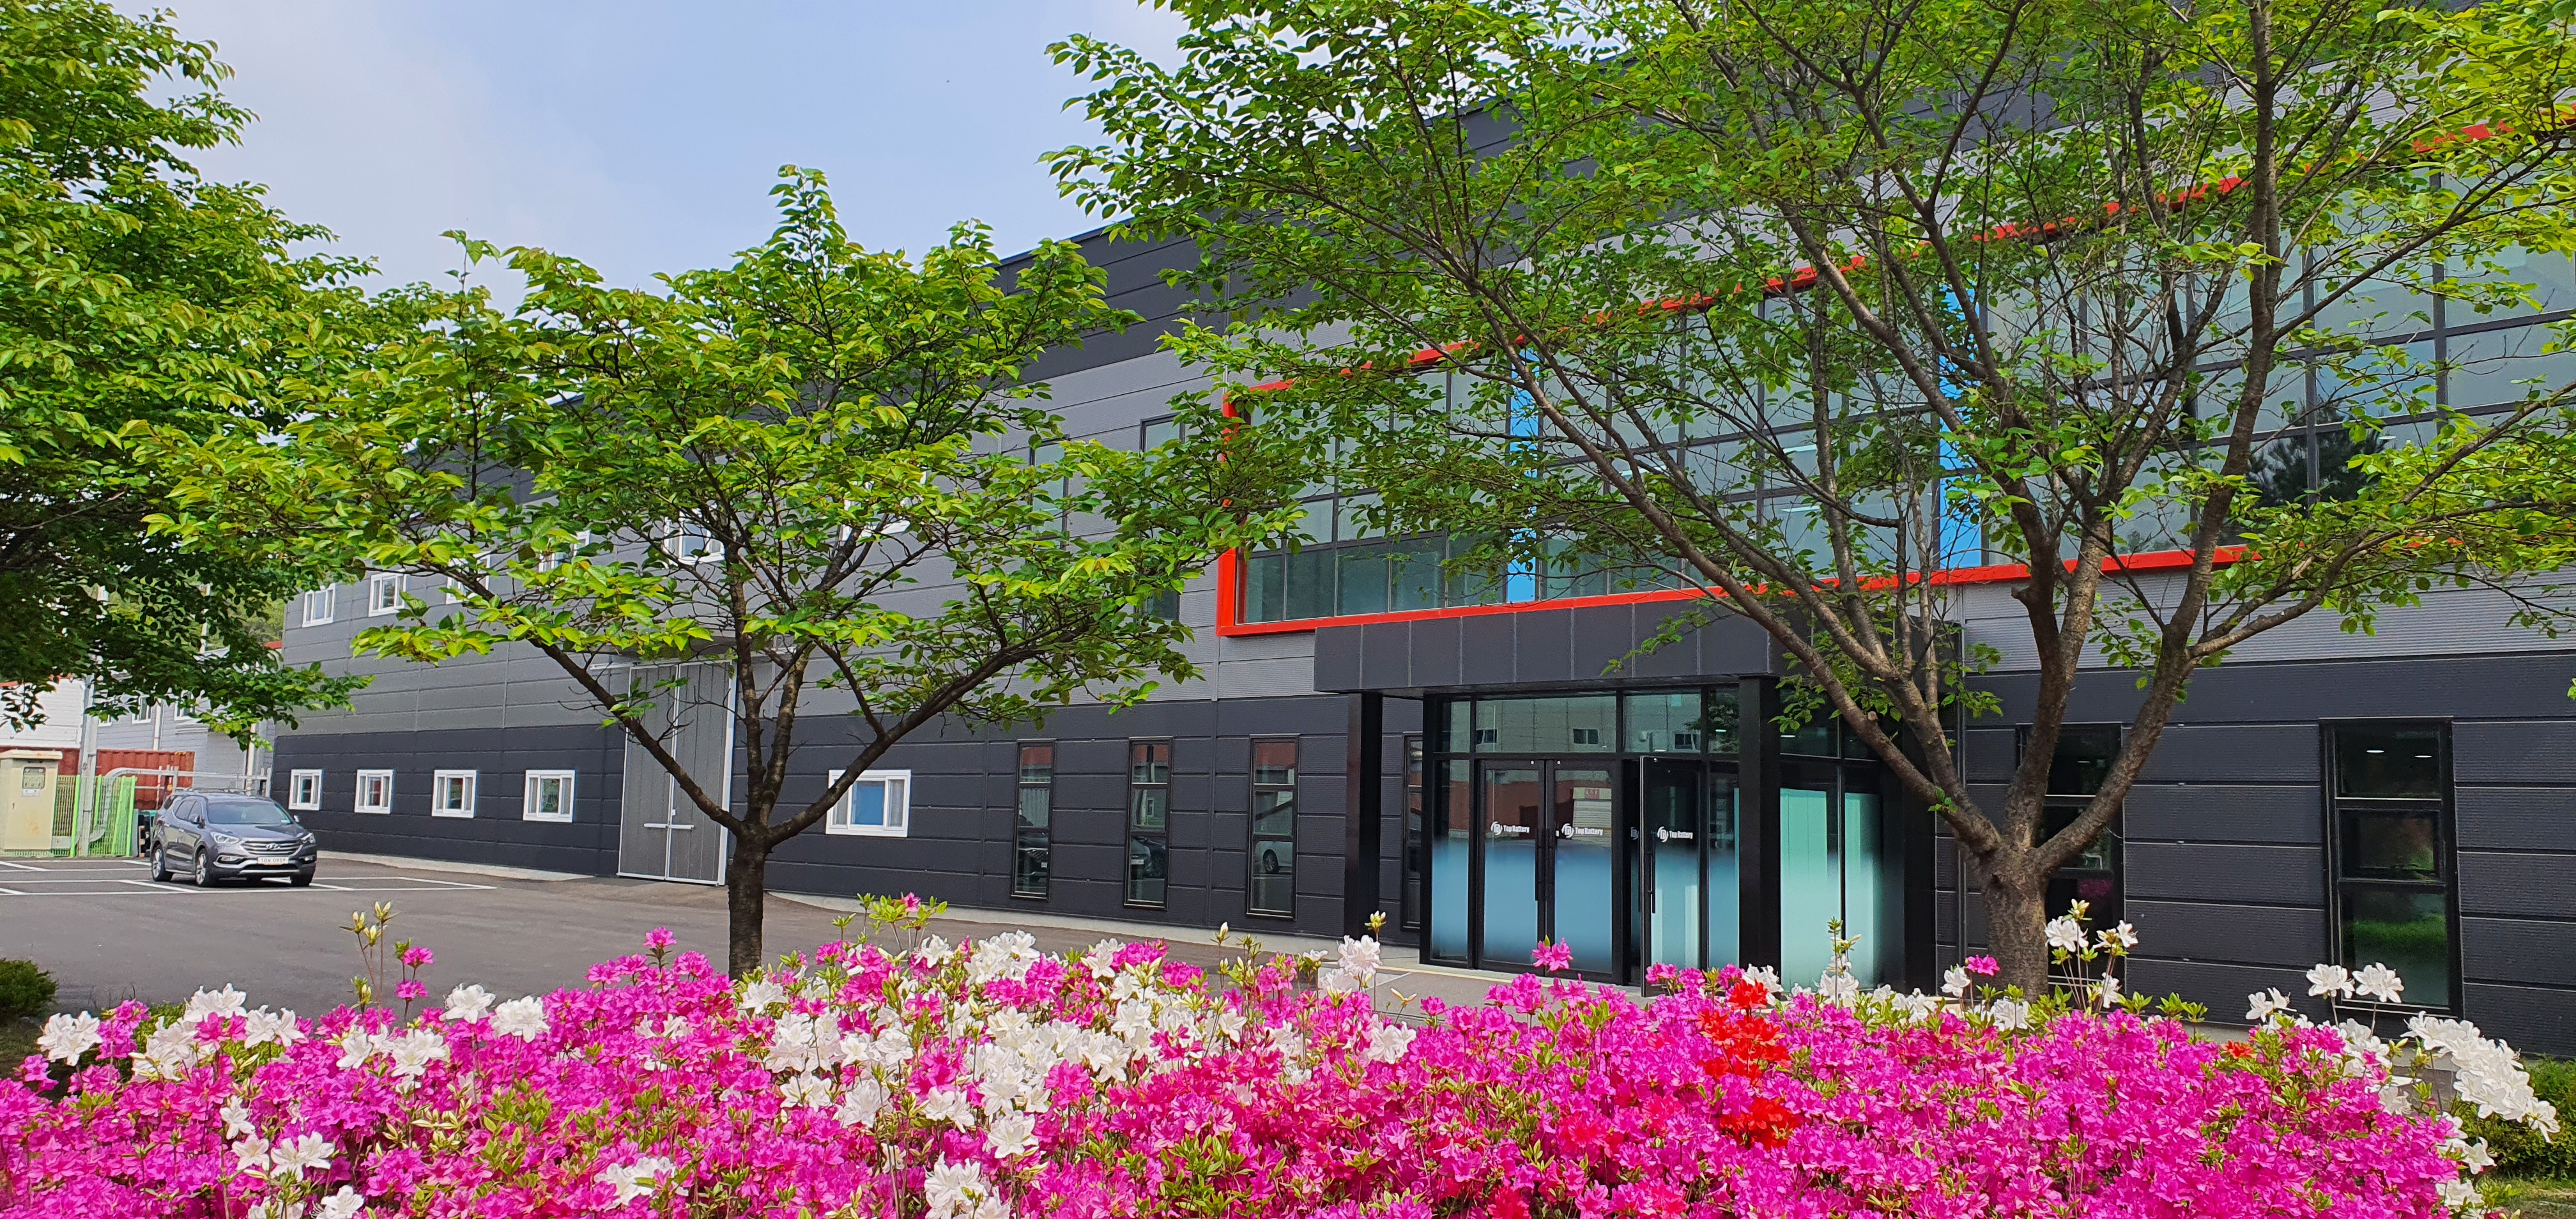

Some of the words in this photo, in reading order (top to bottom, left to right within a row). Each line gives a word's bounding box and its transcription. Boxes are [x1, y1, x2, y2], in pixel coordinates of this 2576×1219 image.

[1512, 825, 1529, 833] Battery
[1575, 827, 1584, 835] Top
[1584, 827, 1604, 836] Battery
